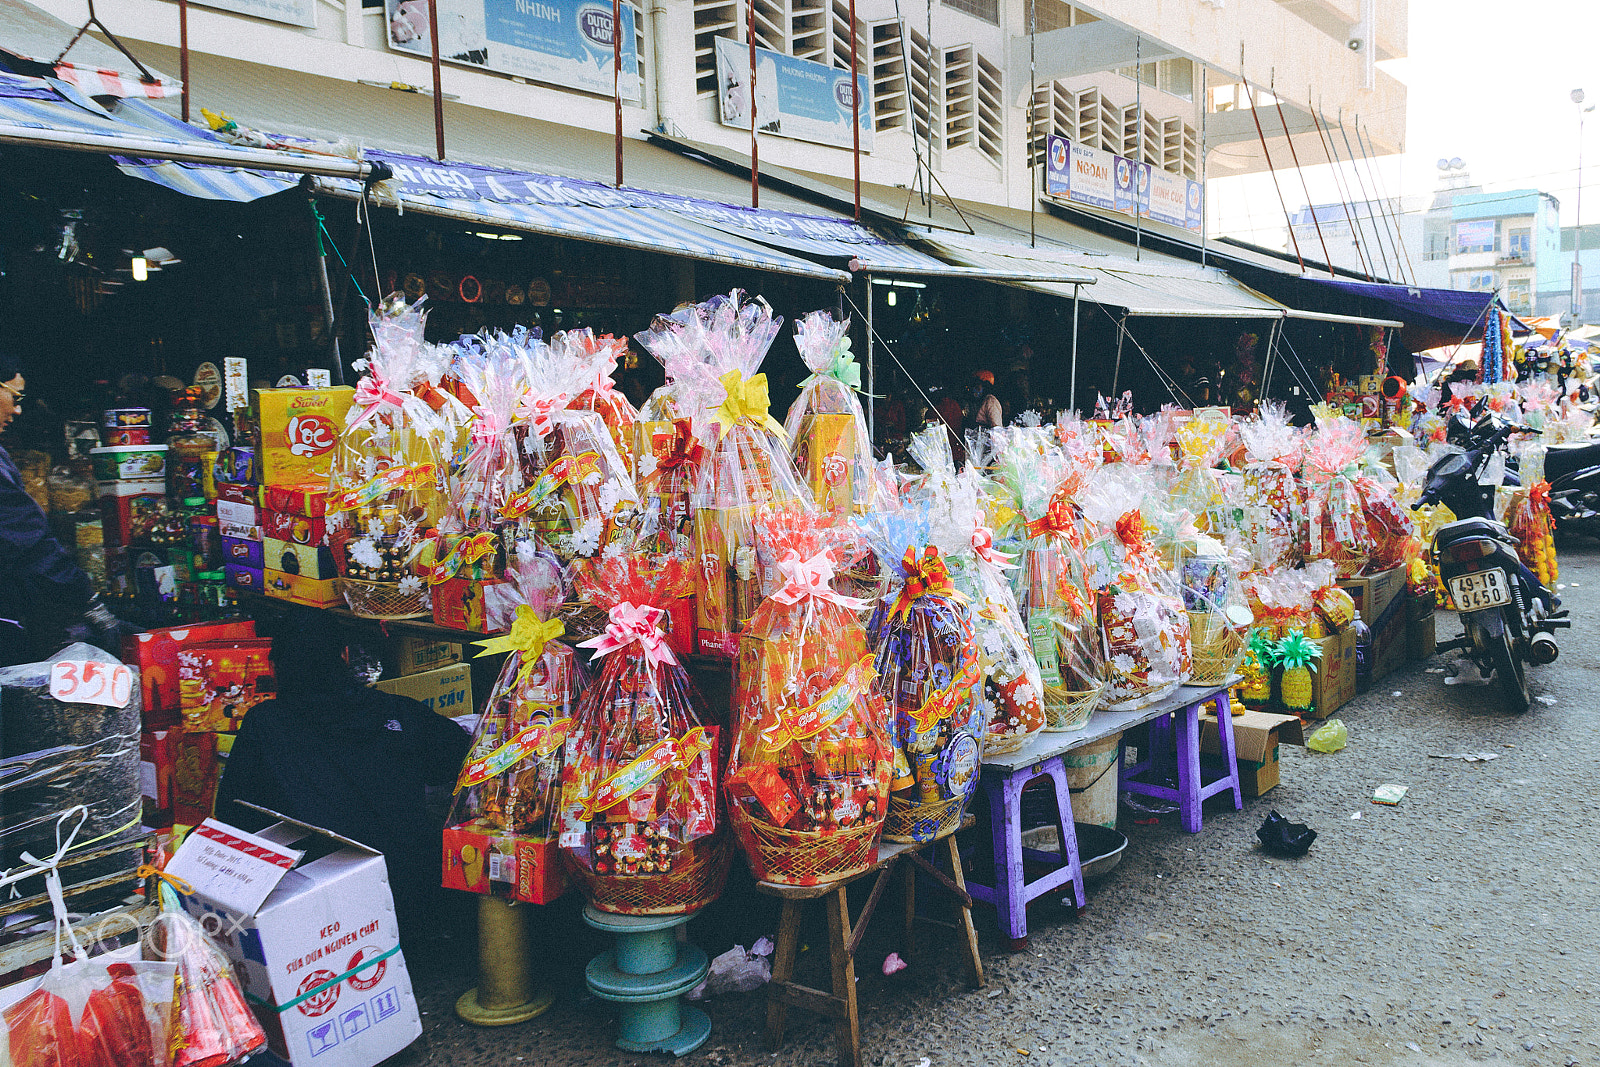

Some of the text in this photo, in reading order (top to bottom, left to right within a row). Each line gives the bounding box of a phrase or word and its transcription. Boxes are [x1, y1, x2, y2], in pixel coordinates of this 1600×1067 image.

[516, 0, 561, 23] NHINH
[587, 14, 614, 31] DUTCH
[591, 27, 613, 41] LADY
[839, 85, 853, 95] DUTC
[842, 94, 853, 106] LAD
[1076, 160, 1108, 180] NGOAN
[290, 395, 329, 409] Sweet
[1458, 573, 1497, 592] 49-T8
[1462, 588, 1501, 608] 9450
[55, 661, 132, 706] 350
[438, 688, 465, 709] SẤY
[320, 920, 341, 940] KẸO
